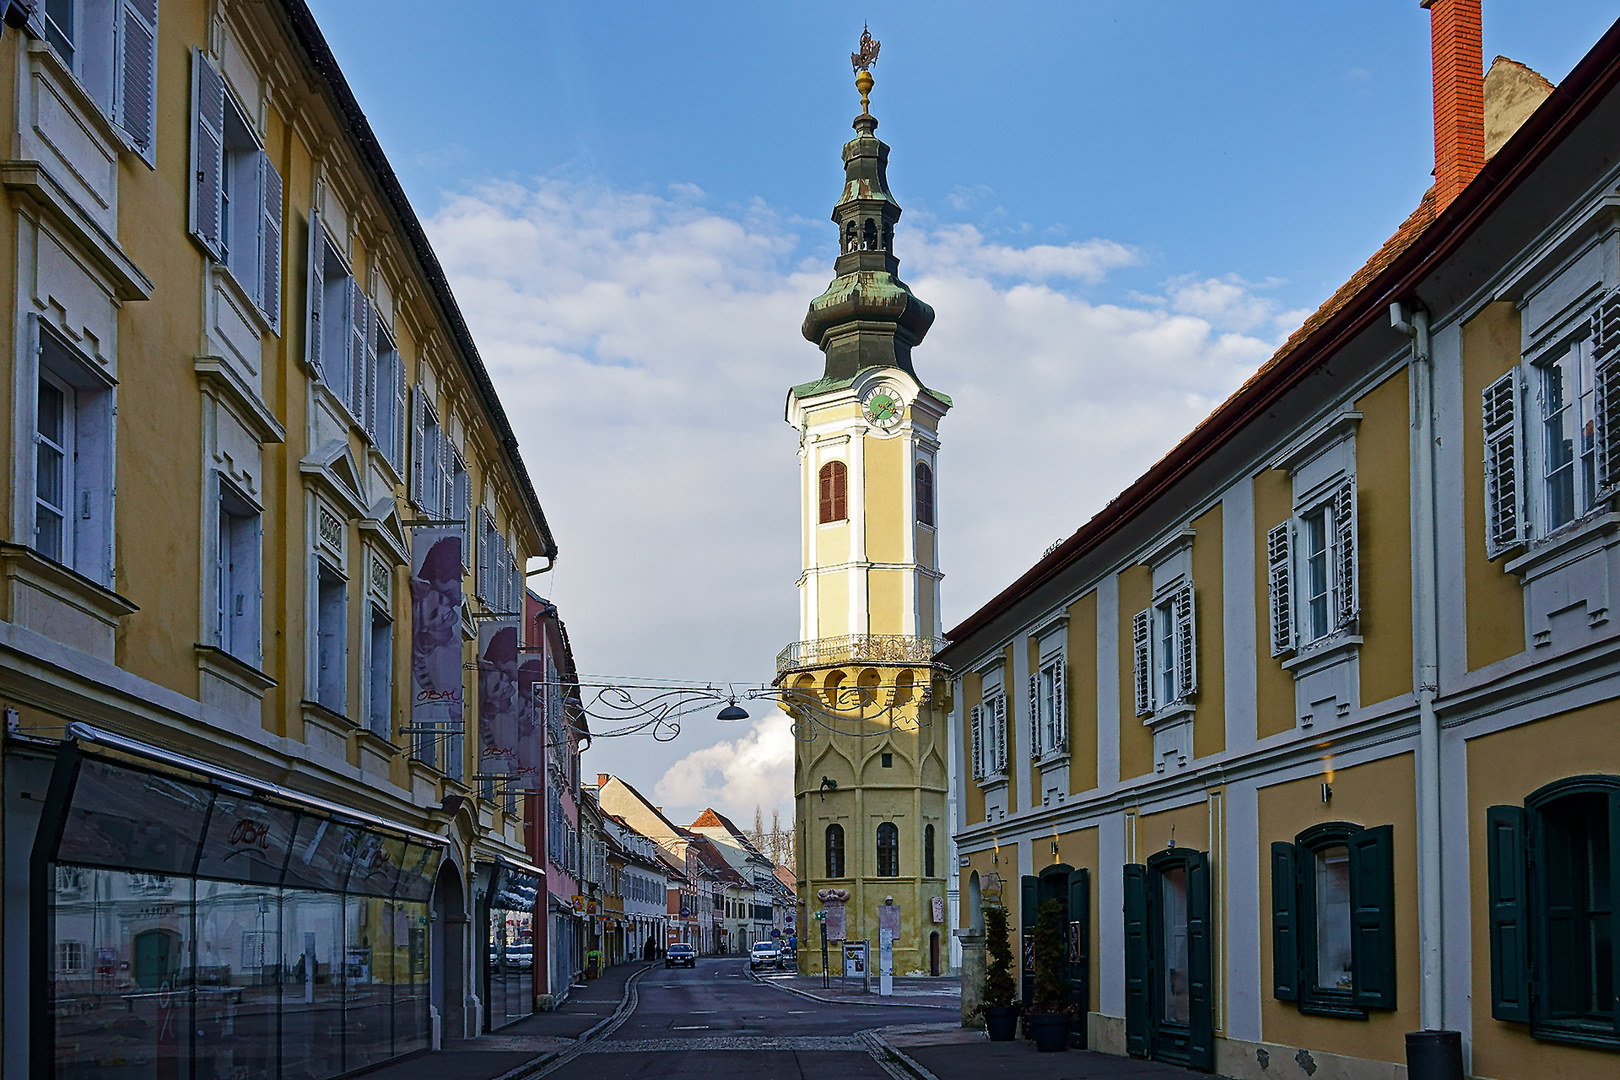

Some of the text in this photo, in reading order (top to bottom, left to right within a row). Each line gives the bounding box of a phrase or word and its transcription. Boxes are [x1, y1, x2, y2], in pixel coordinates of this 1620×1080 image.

[417, 690, 460, 701] OBAL
[482, 747, 517, 756] OBAL
[518, 766, 539, 774] BAL
[231, 819, 271, 850] OBAL
